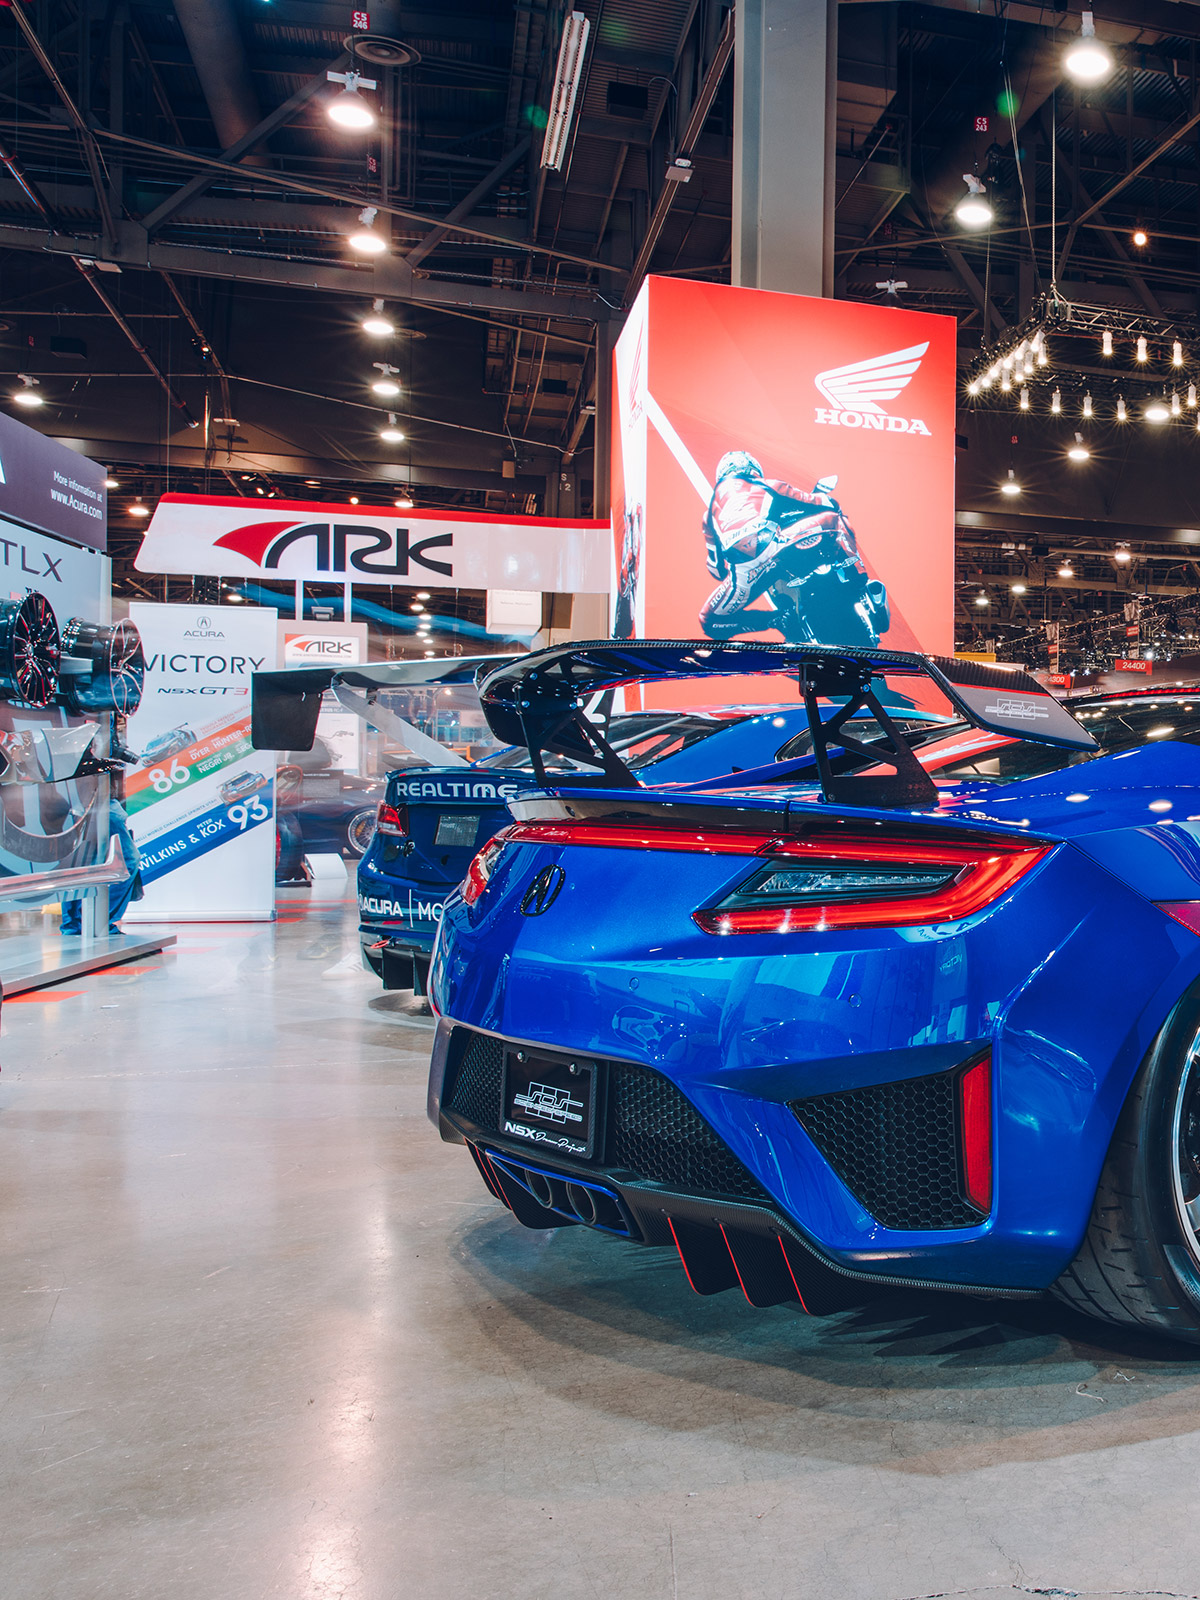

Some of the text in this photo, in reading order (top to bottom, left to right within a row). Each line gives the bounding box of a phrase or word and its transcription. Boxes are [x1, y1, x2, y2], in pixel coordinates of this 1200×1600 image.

[353, 19, 368, 29] 246
[354, 12, 367, 21] C5
[814, 407, 932, 436] HONDA
[54, 470, 103, 503] More information at
[51, 488, 103, 520] www.Acura.com
[0, 538, 63, 582] TLX
[265, 523, 453, 577] ARK
[183, 630, 225, 638] ACURA
[305, 641, 352, 654] ARK
[143, 653, 266, 676] VICTORY
[1122, 661, 1146, 670] 24400
[190, 746, 210, 761] DYER
[198, 757, 223, 773] NEGRI
[223, 751, 235, 762] JR.
[148, 758, 191, 794] 86
[396, 782, 518, 799] REALTIME
[227, 794, 269, 831] 93
[196, 818, 213, 830] PETER
[138, 819, 226, 871] WILKINS & KOX
[363, 896, 404, 917] ACURA
[504, 1121, 536, 1140] NSX
